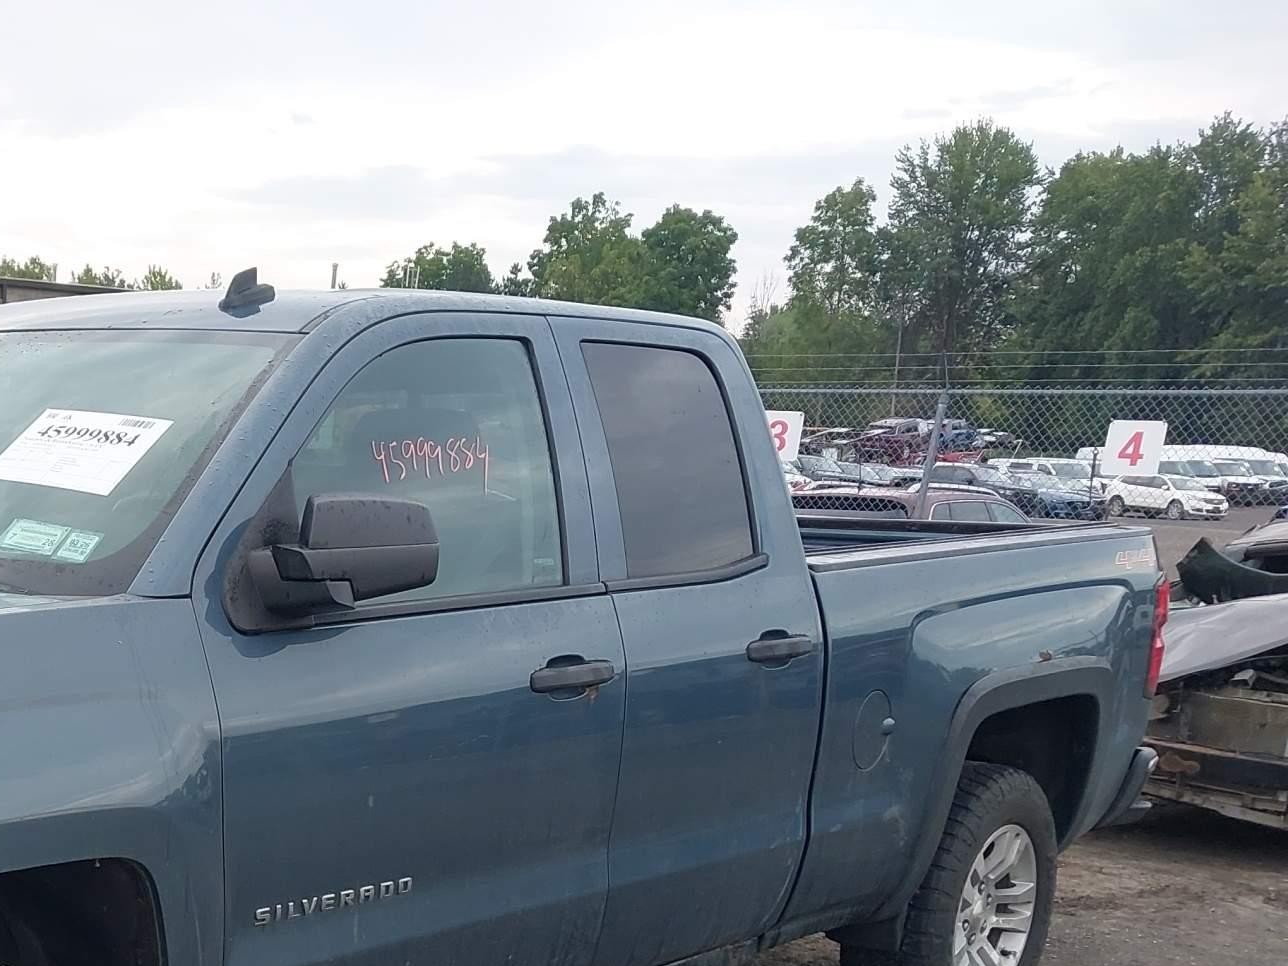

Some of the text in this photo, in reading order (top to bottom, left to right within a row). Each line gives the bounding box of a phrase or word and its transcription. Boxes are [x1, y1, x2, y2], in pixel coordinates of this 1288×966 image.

[37, 424, 141, 447] 45999884
[770, 420, 789, 451] 3
[1117, 431, 1144, 466] 4
[371, 435, 489, 496] 45999884
[254, 877, 412, 926] SILVERADO
